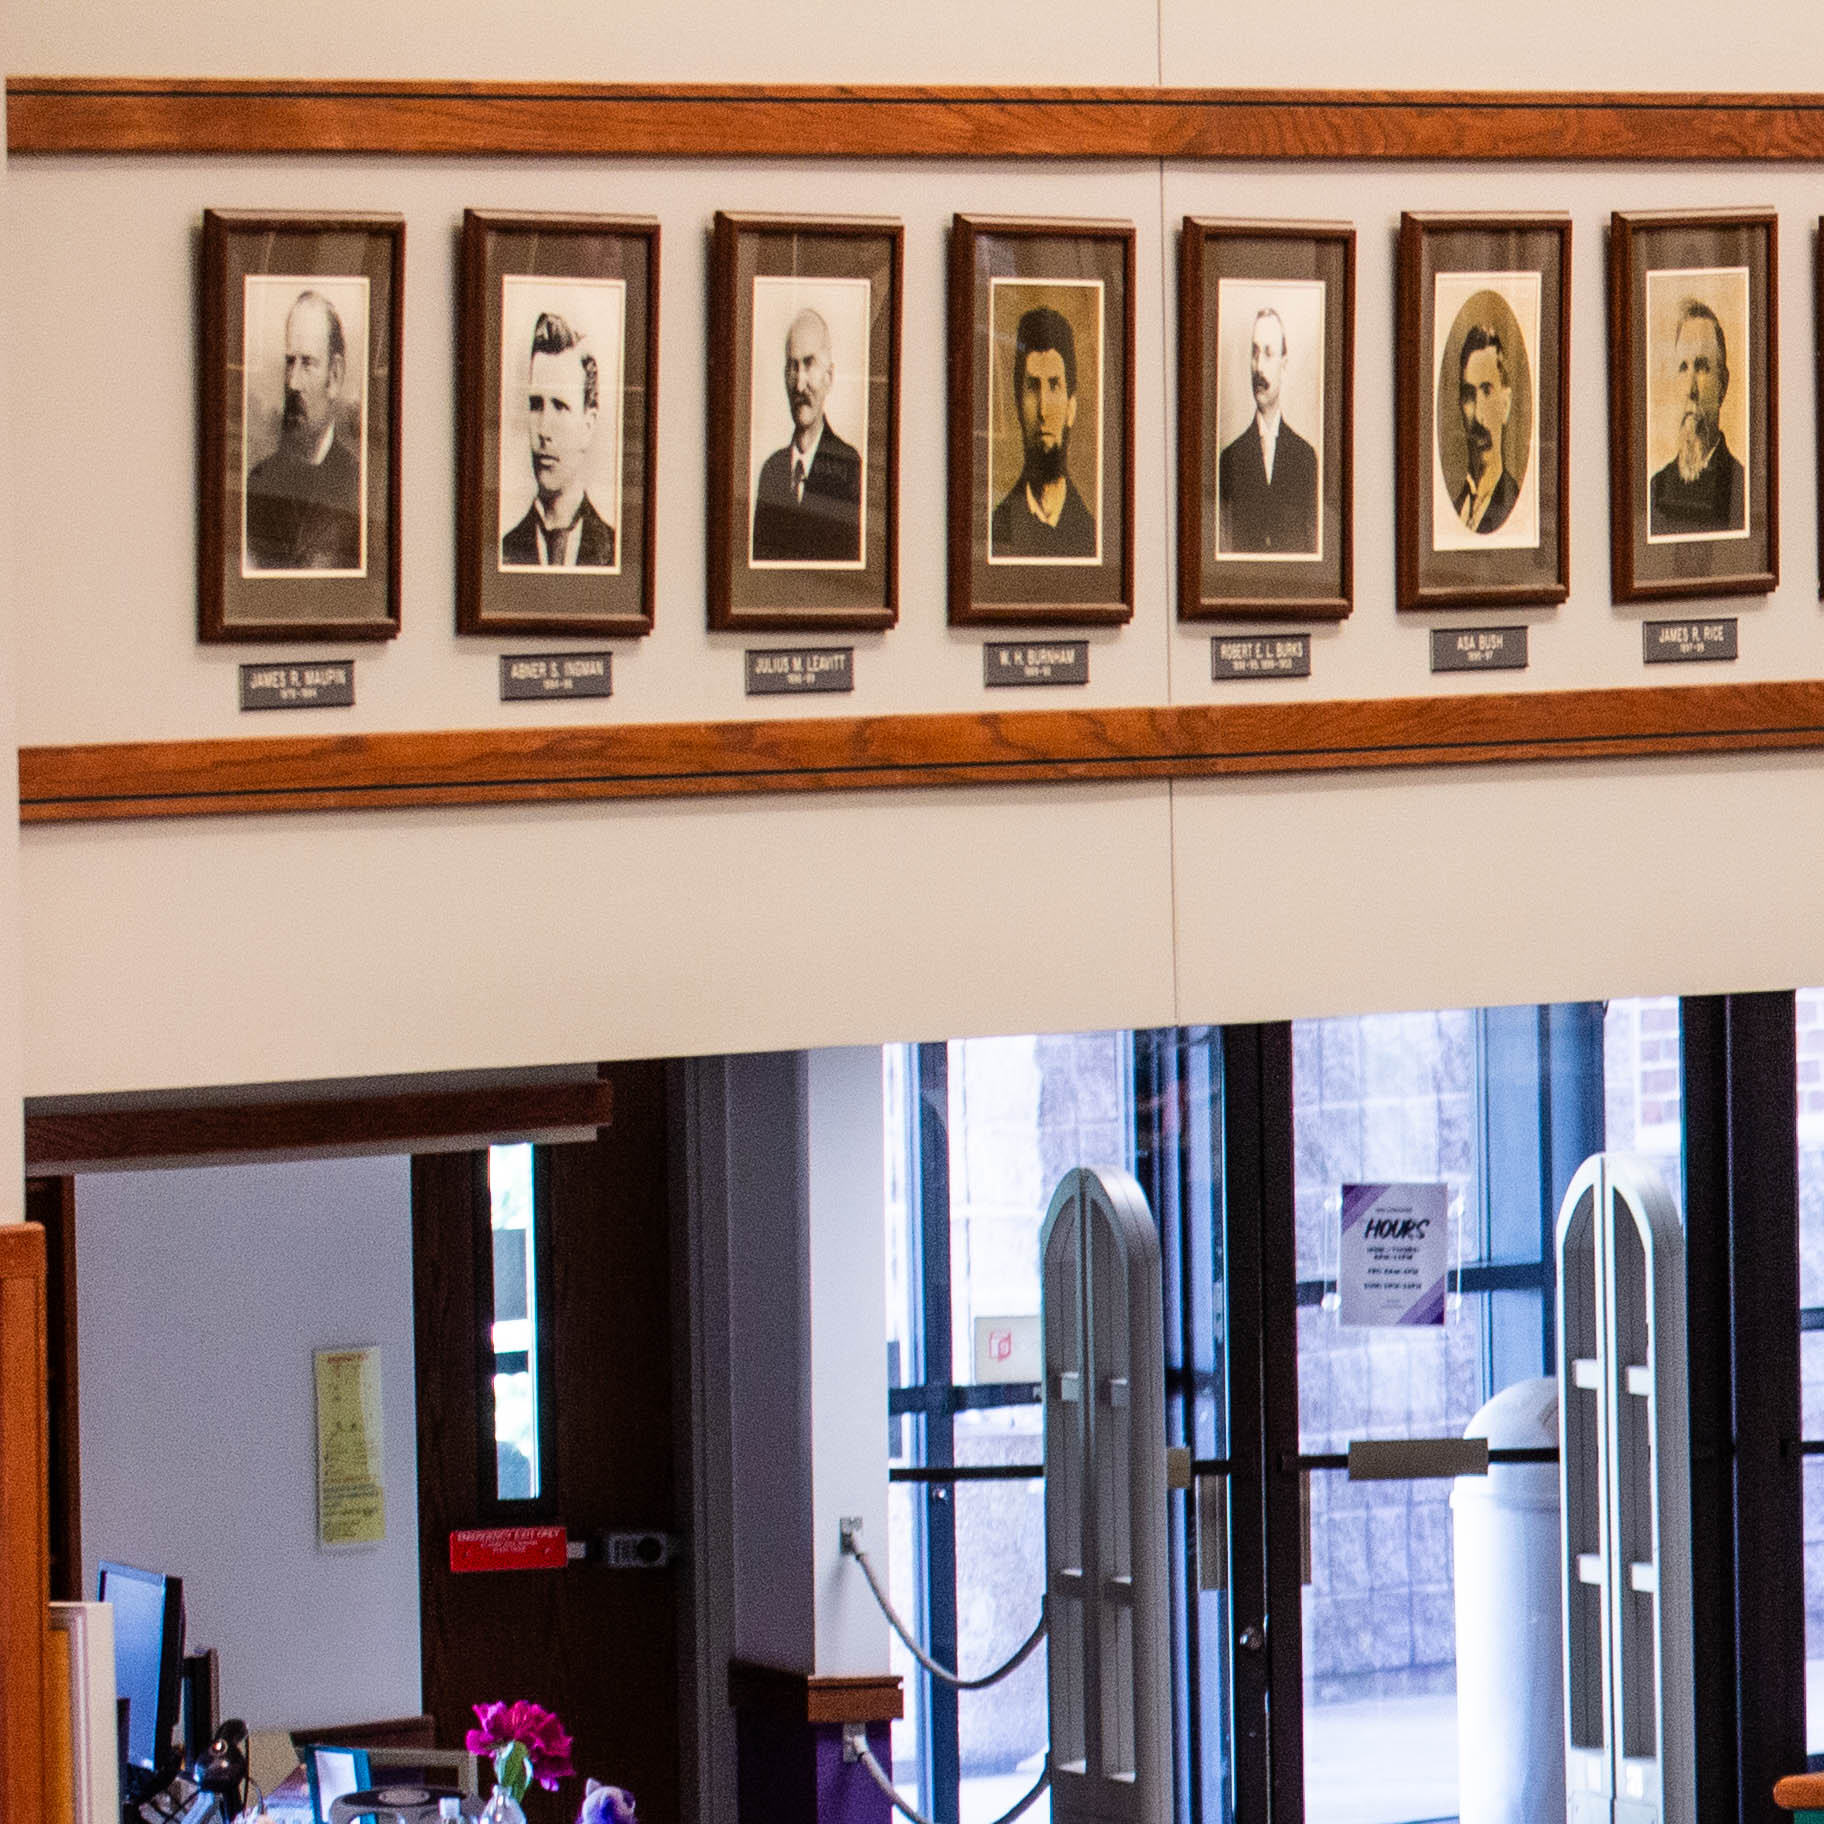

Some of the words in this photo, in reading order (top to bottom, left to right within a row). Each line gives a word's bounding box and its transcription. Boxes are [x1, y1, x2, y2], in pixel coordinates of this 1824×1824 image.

[1478, 633, 1505, 650] BUSH
[1658, 626, 1690, 644] JAMES
[1703, 624, 1725, 642] RICE
[1364, 1217, 1431, 1240] HOURS
